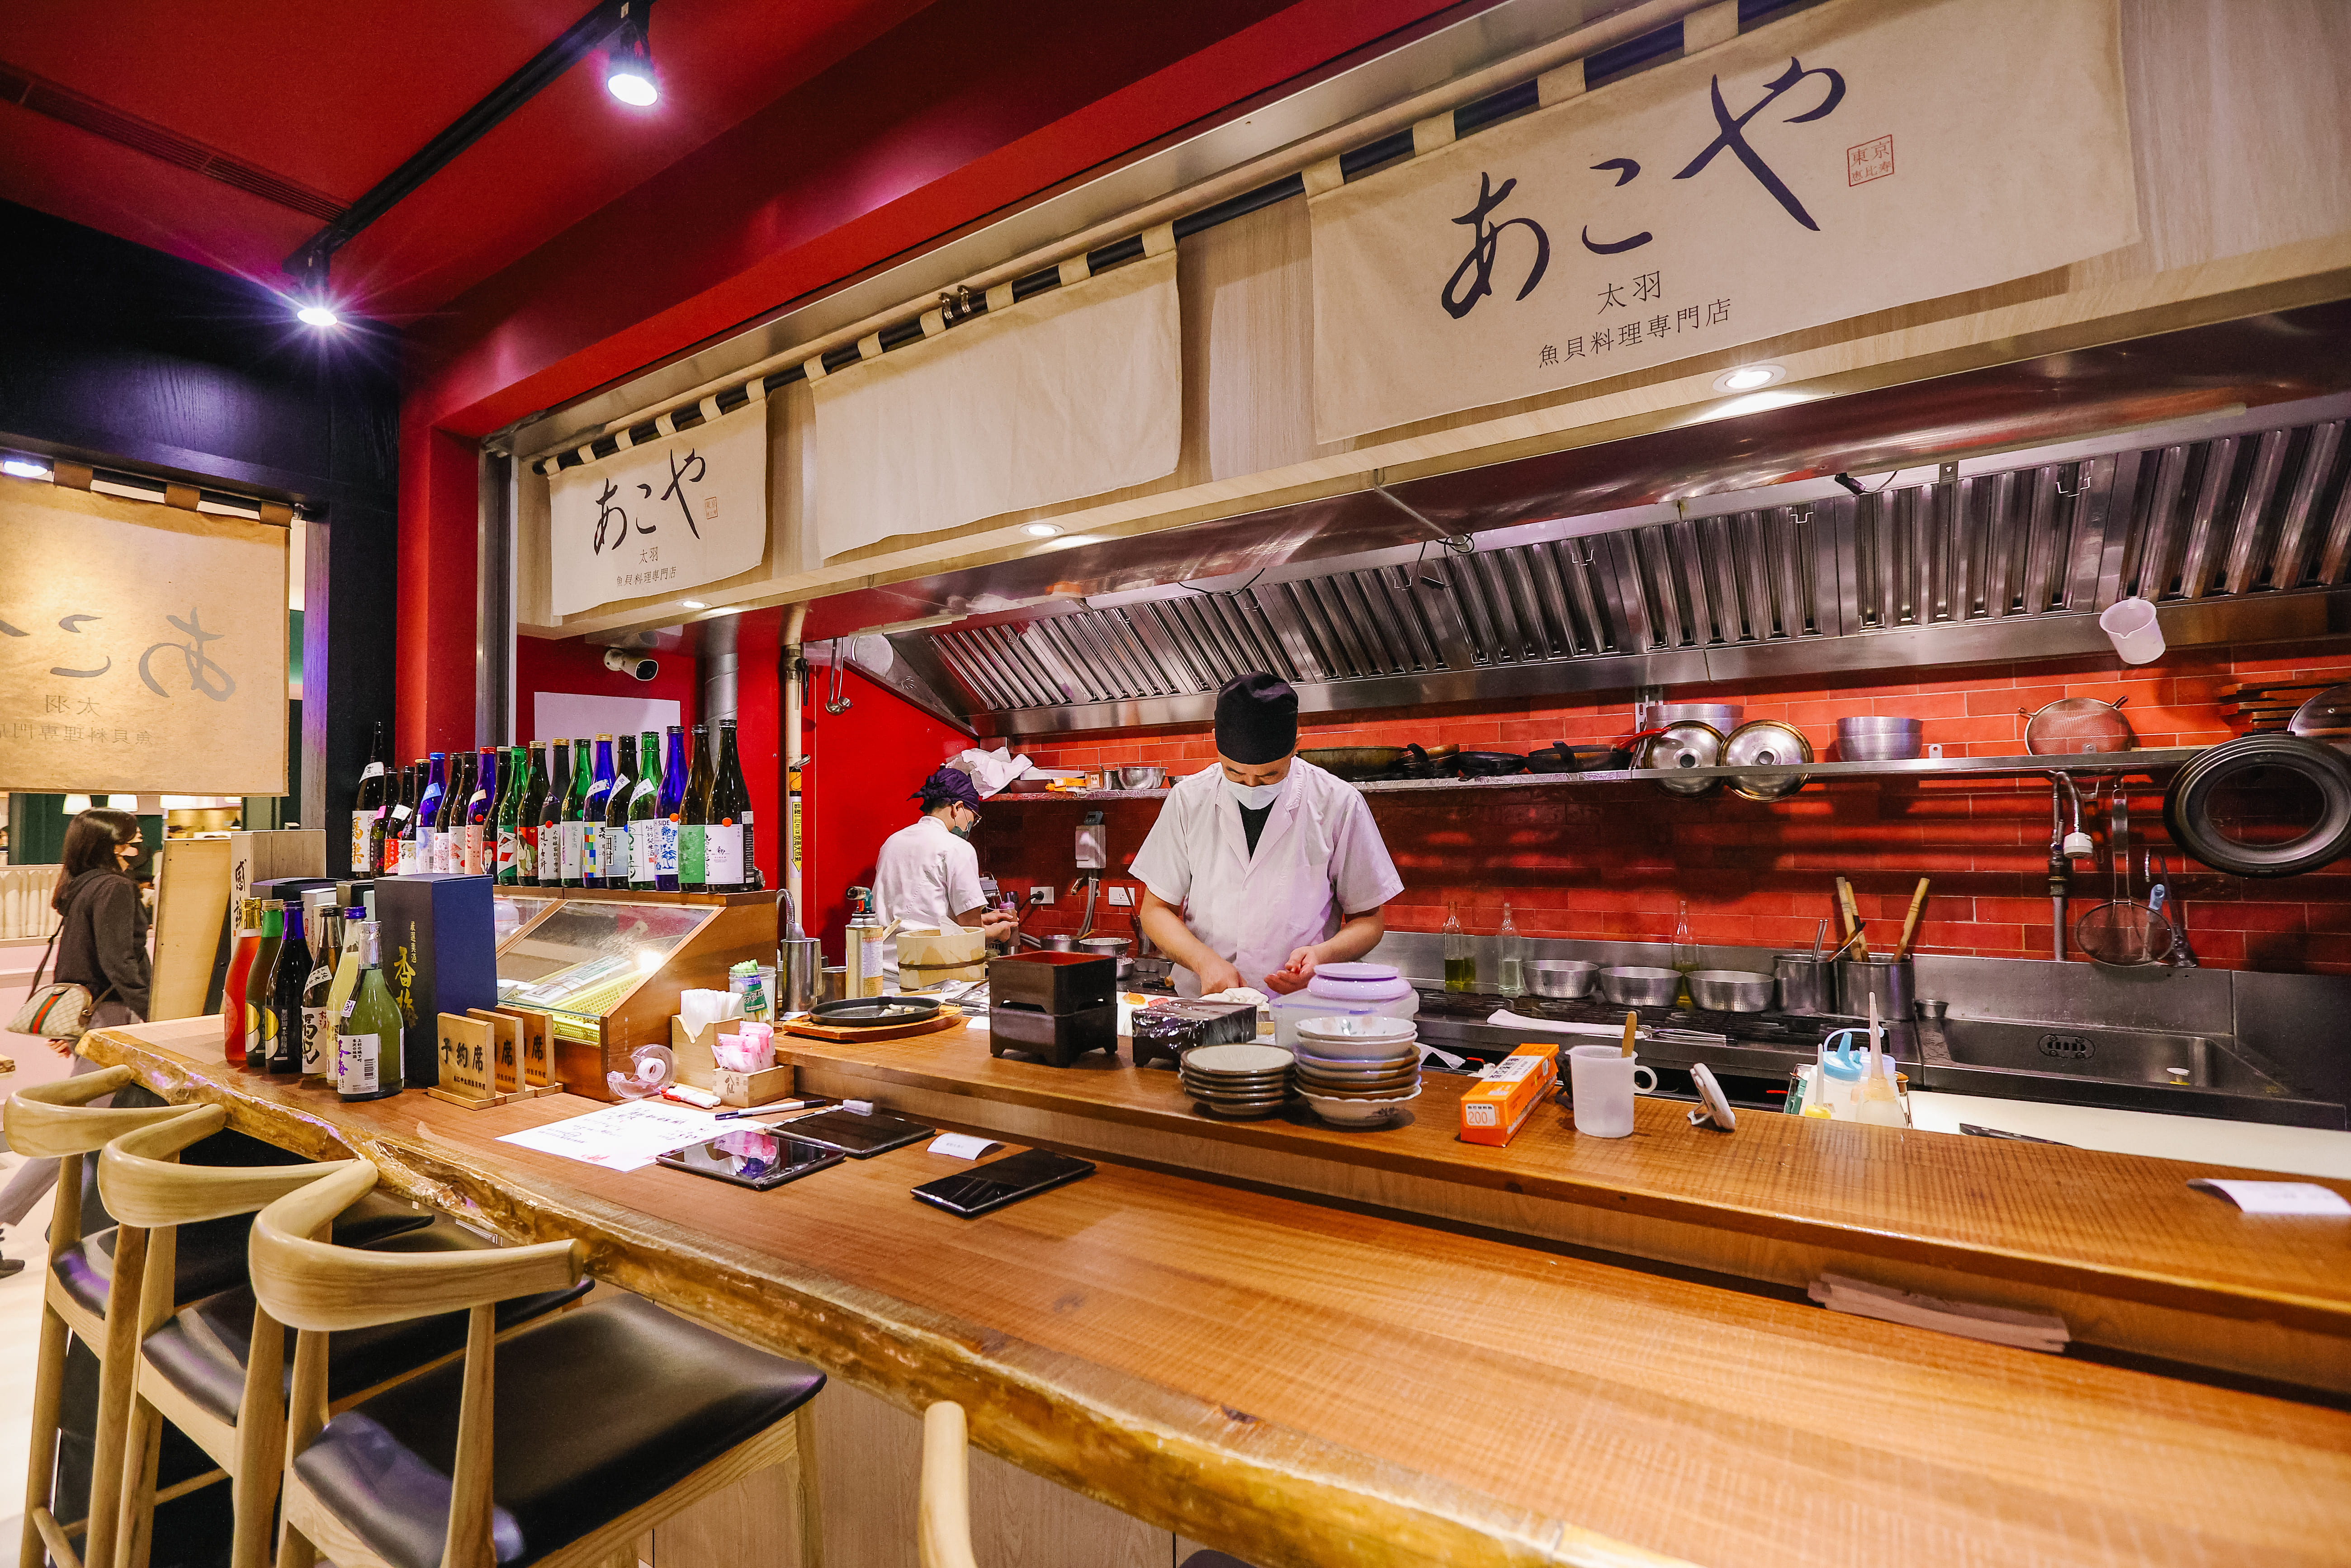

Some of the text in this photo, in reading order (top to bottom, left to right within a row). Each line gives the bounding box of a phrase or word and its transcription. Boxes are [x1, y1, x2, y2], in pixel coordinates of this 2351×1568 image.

[1851, 141, 1890, 167] 東京
[1441, 56, 1846, 320] あこや
[1597, 270, 1662, 315] 太羽
[1538, 298, 1732, 368] 魚貝料理専門店
[594, 448, 706, 556] あこや
[639, 546, 658, 564] 太羽
[616, 566, 677, 586] 魚貝料理専門店
[441, 1038, 483, 1074] 予約席
[1468, 1111, 1488, 1124] 200
